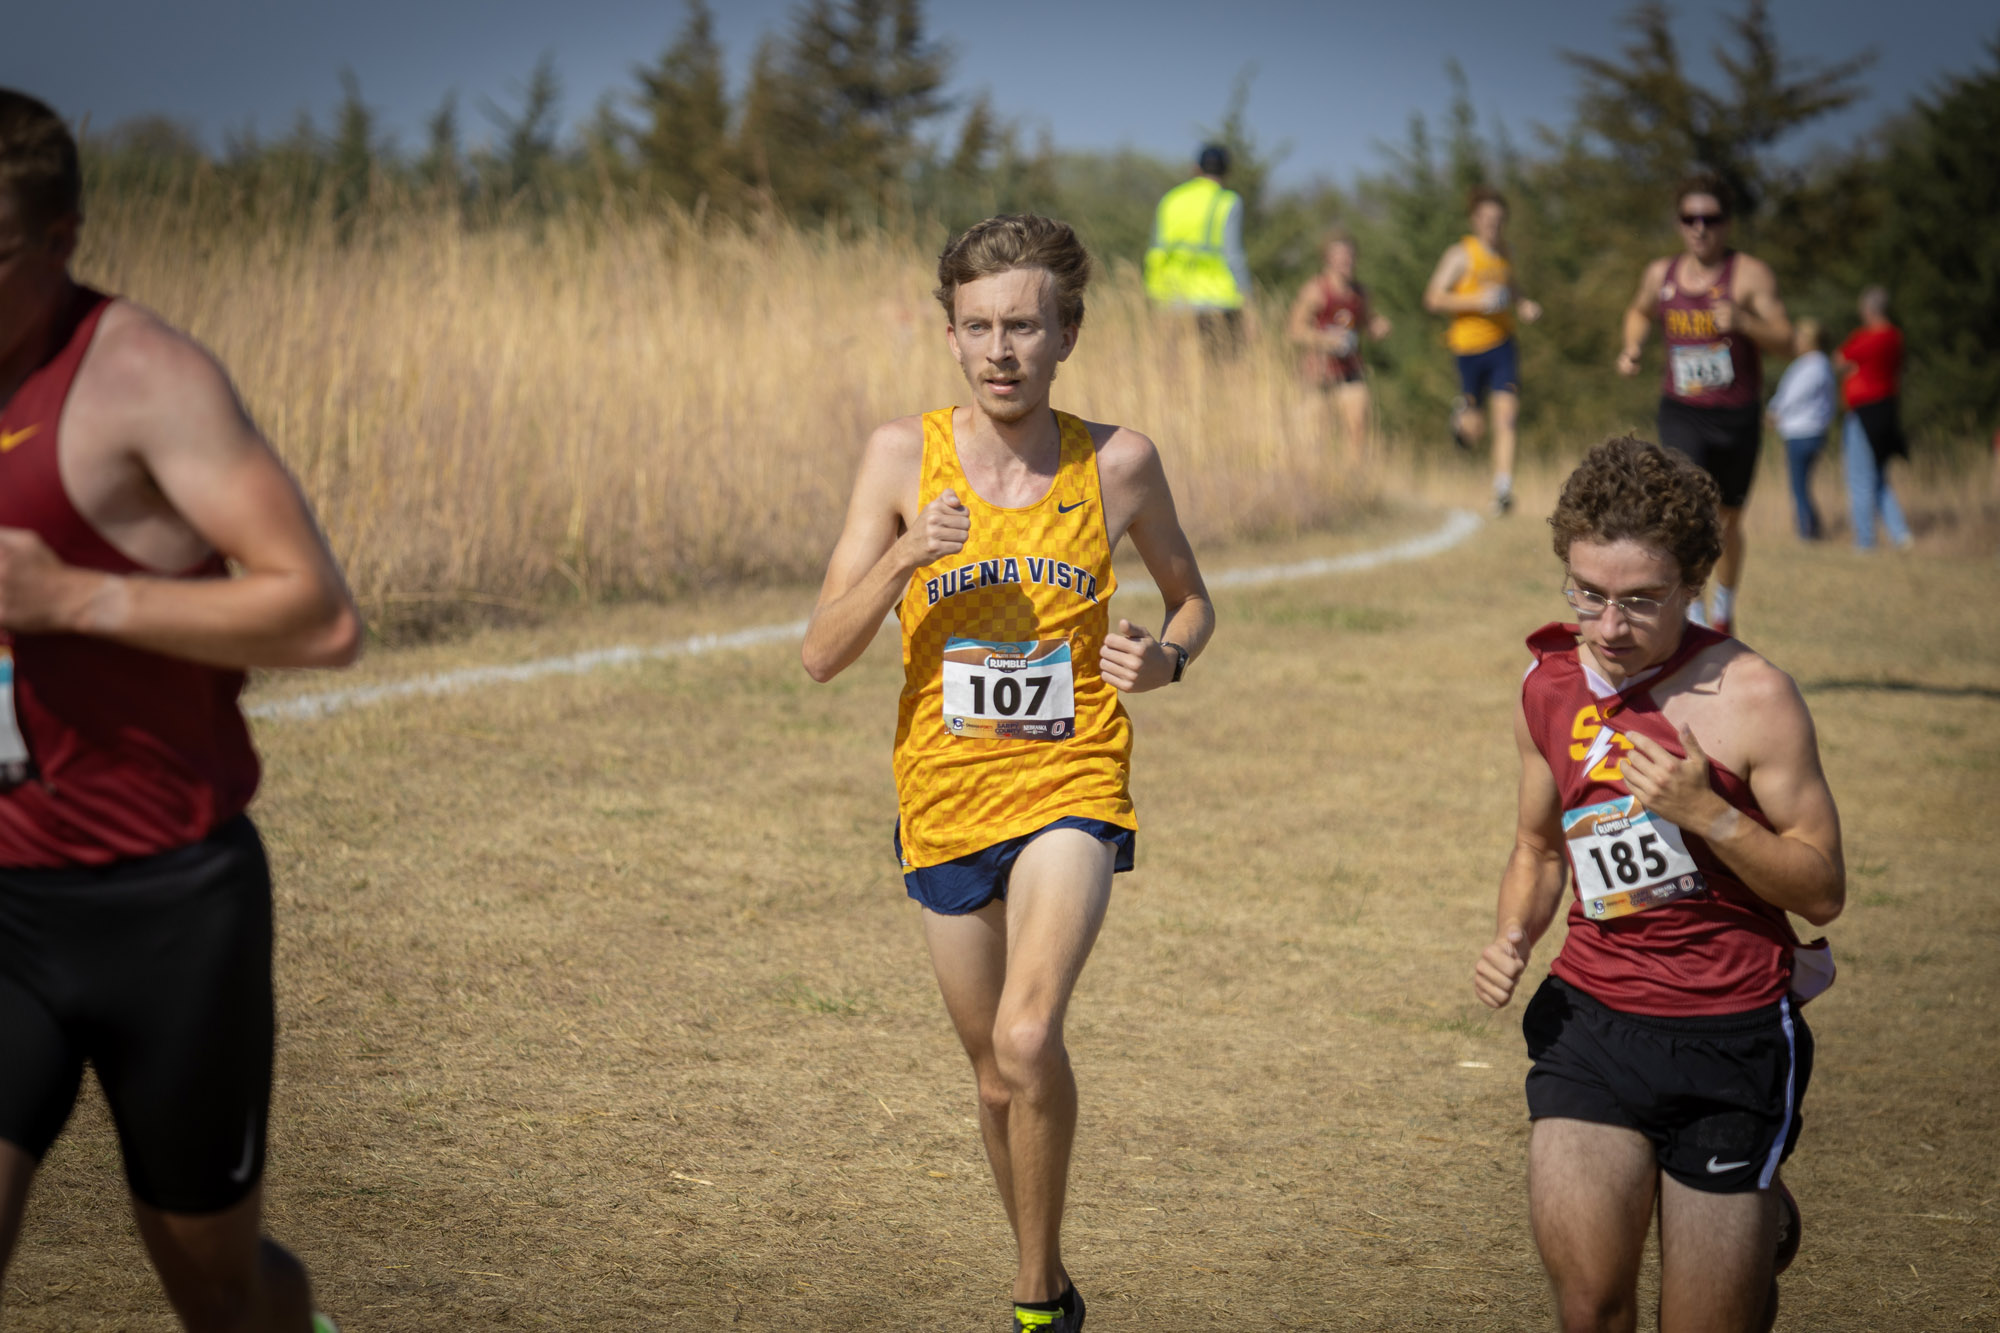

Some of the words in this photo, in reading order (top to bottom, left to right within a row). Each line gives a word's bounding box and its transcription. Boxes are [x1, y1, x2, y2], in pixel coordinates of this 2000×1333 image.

[926, 557, 1021, 607] BUENA
[1025, 557, 1099, 604] VISTA
[990, 659, 1027, 668] RUMBLE
[970, 675, 1053, 716] 107
[1597, 817, 1631, 834] RUMBLE
[1589, 833, 1669, 891] 185
